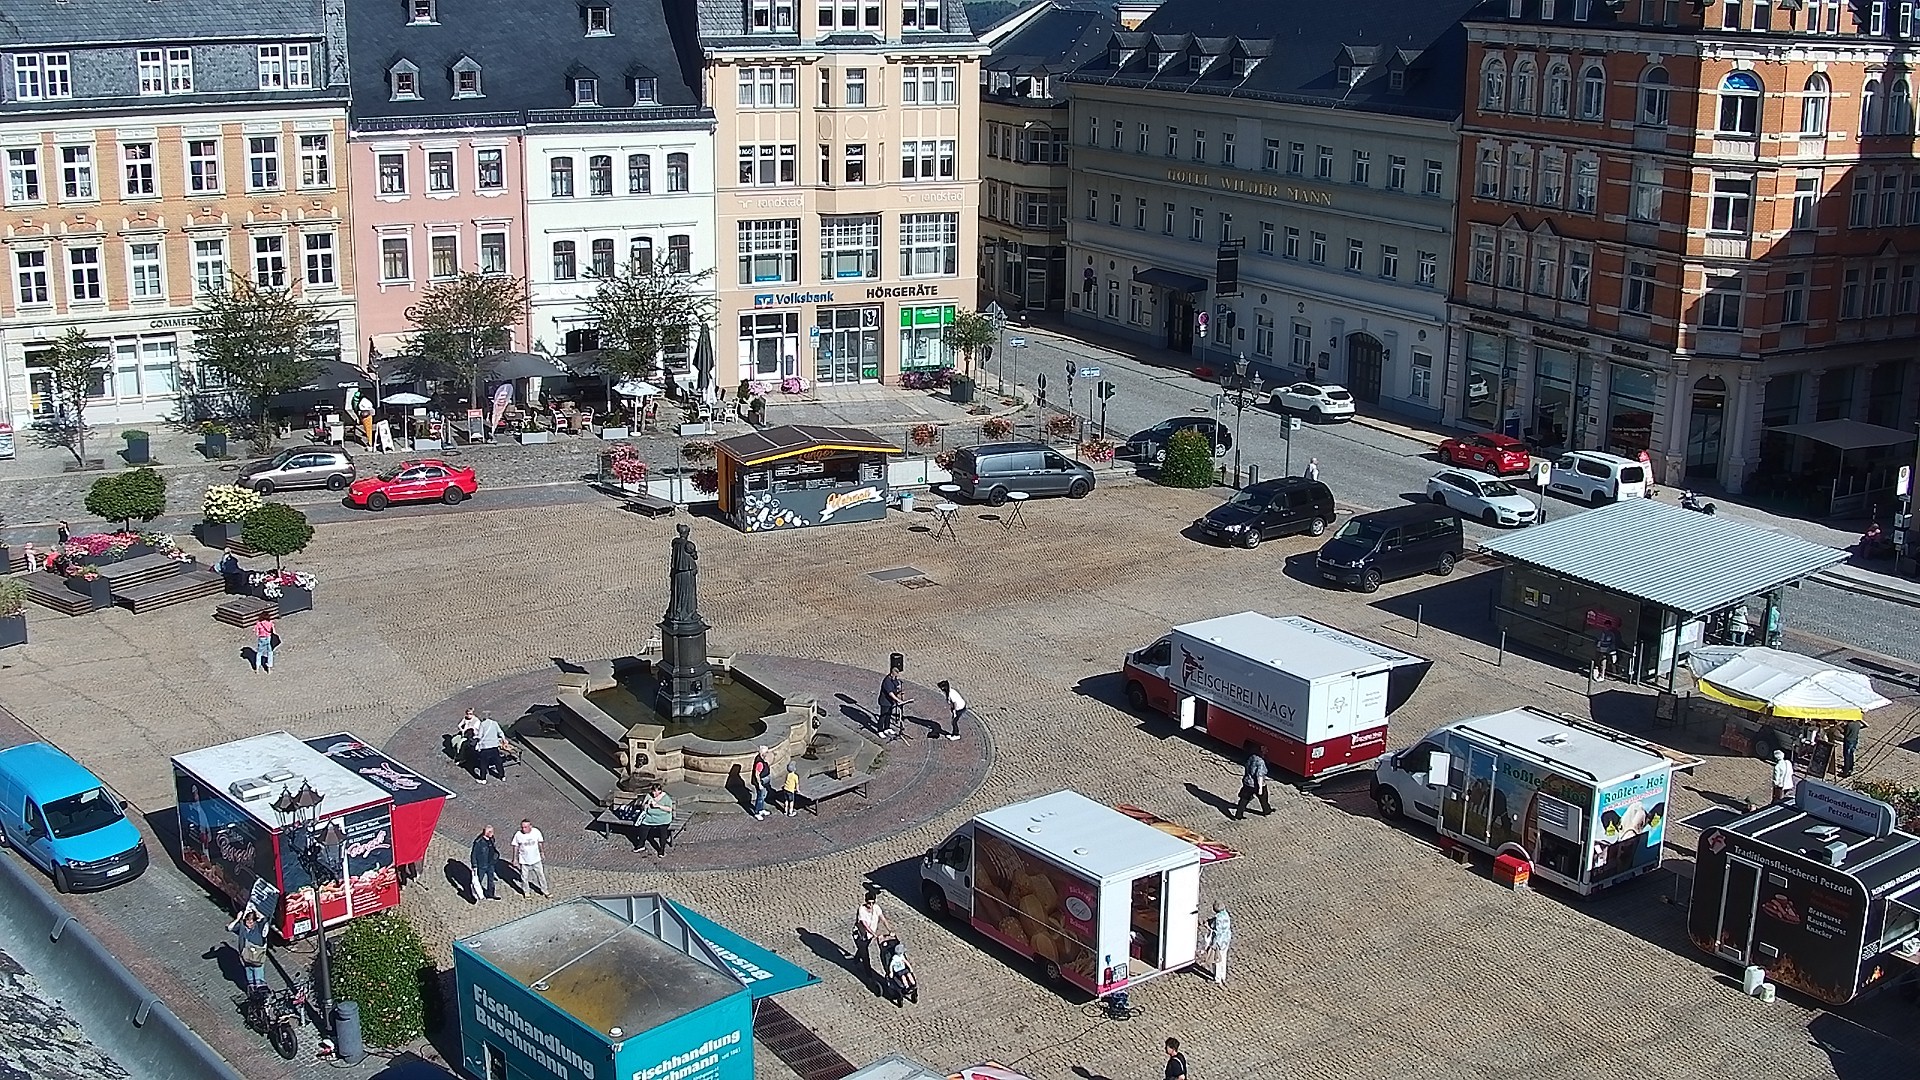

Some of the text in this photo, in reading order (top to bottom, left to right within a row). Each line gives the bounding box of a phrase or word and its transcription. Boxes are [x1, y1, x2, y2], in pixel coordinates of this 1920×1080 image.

[1167, 168, 1332, 206] HOTEL WILDER MANN
[775, 291, 834, 305] Volksbank
[866, 285, 938, 299] HÖRGERÄTE
[1603, 784, 1638, 804] Roßler
[1646, 773, 1665, 790] Hof
[1808, 789, 1878, 819] Traditionsfleischerei
[1828, 806, 1854, 821] Petzold
[1734, 845, 1818, 884] Traditionsfleischerei
[1820, 877, 1853, 896] Petzold
[1808, 907, 1842, 925] Bratwurst
[473, 983, 595, 1080] Fischhandlung
[474, 1006, 569, 1080] Buschmann
[632, 1028, 741, 1080] Fischhandlung
